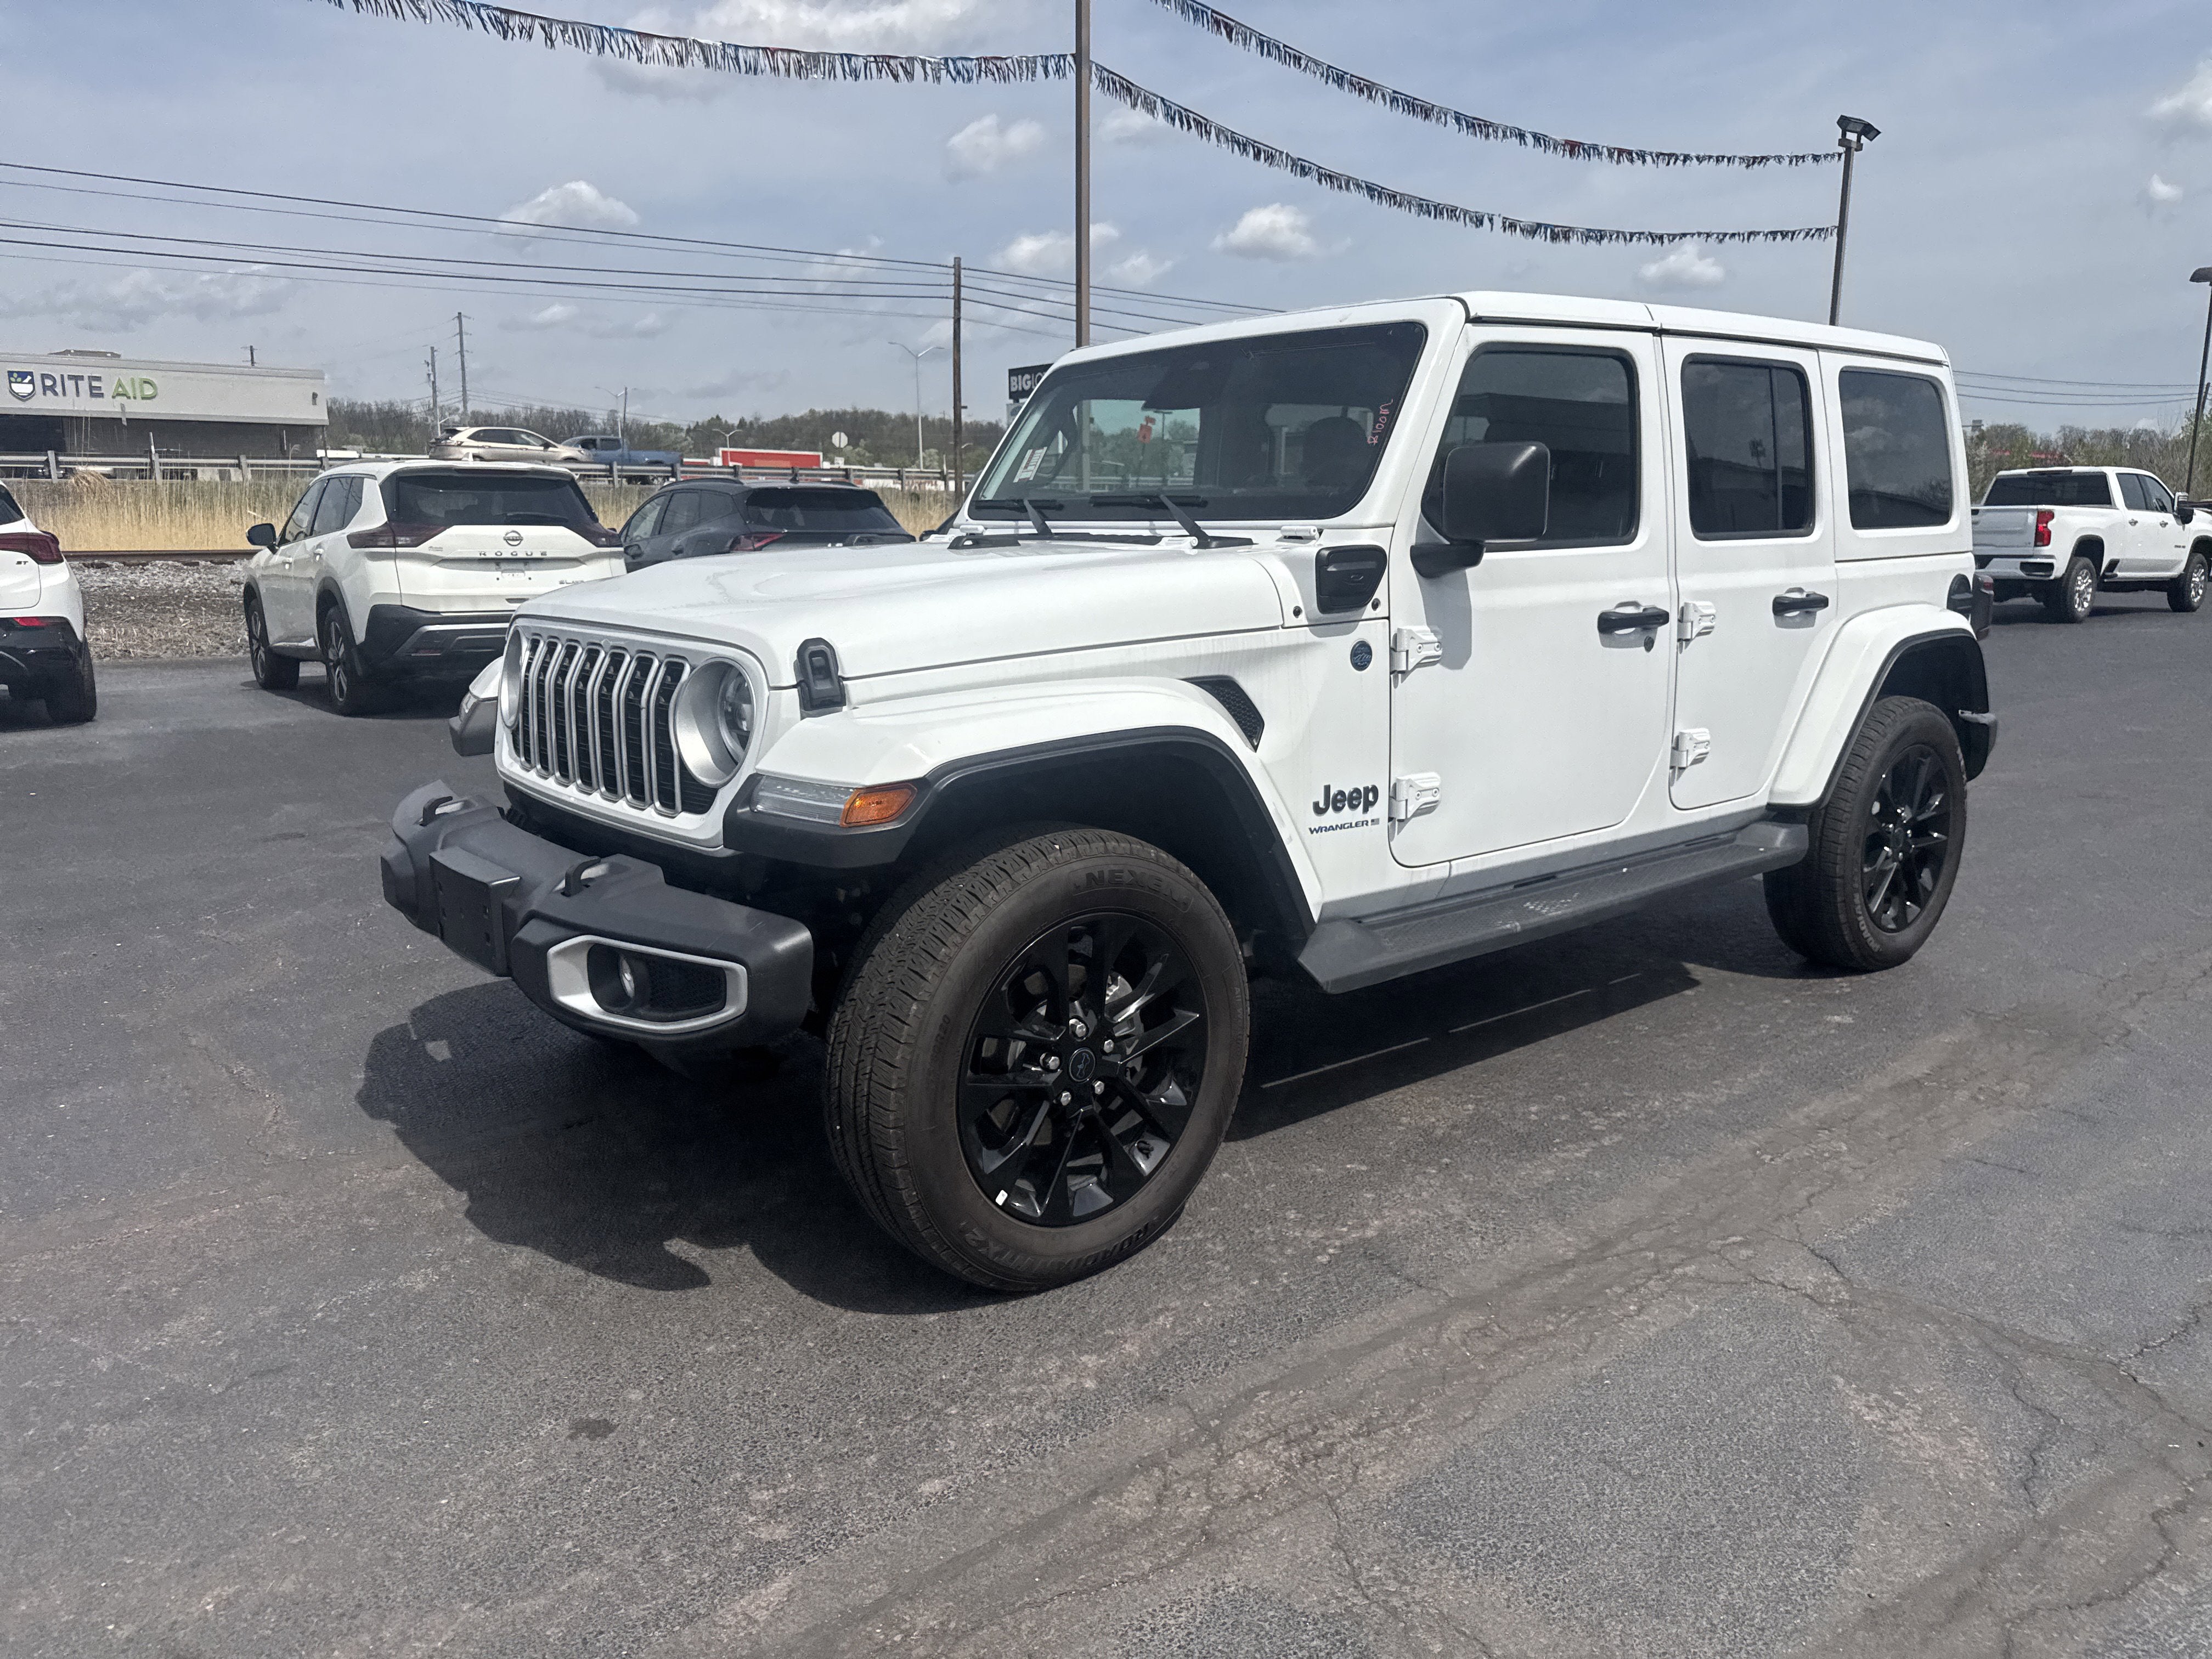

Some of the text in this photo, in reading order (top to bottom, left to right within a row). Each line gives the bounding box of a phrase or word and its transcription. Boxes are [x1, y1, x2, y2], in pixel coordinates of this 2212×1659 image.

[40, 373, 158, 399] RITE AID
[1313, 784, 1379, 816] Jeep
[1308, 820, 1369, 834] WRANGLER
[1085, 868, 1182, 902] NEXEN
